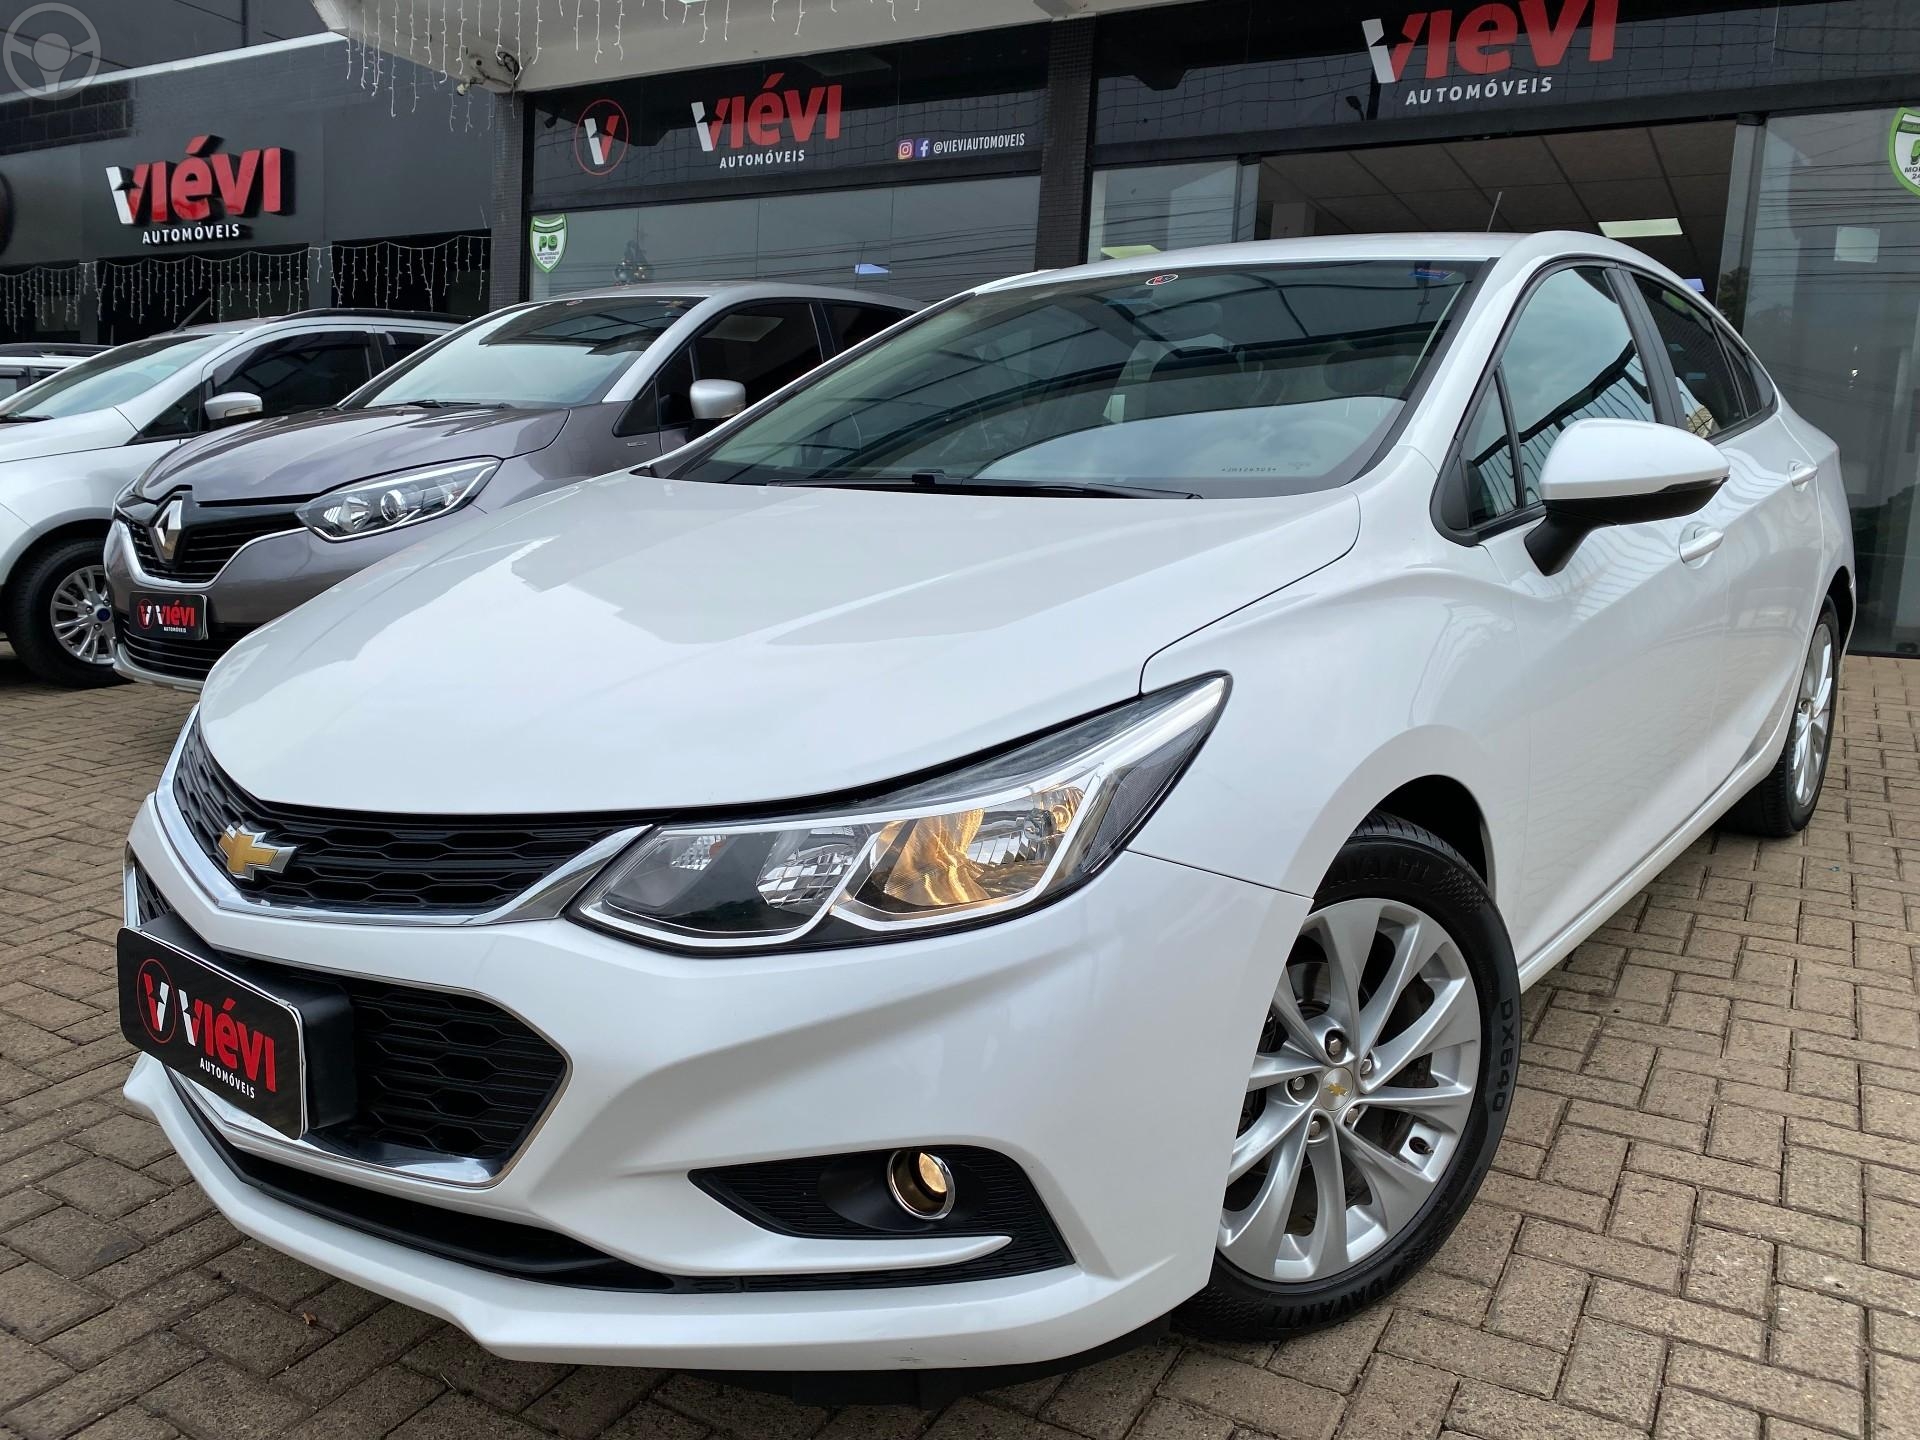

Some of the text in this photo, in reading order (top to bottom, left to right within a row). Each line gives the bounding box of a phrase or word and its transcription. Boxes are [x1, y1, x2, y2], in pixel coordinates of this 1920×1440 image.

[1405, 75, 1553, 106] AUTOMÓVEIS
[933, 132, 1026, 155] @VIEVIAUTOMOVEIS
[719, 148, 806, 169] AUTOMÓVEIS
[141, 222, 241, 246] AUTOMÓVEIS
[199, 1056, 256, 1100] AUTOMÓVEIS
